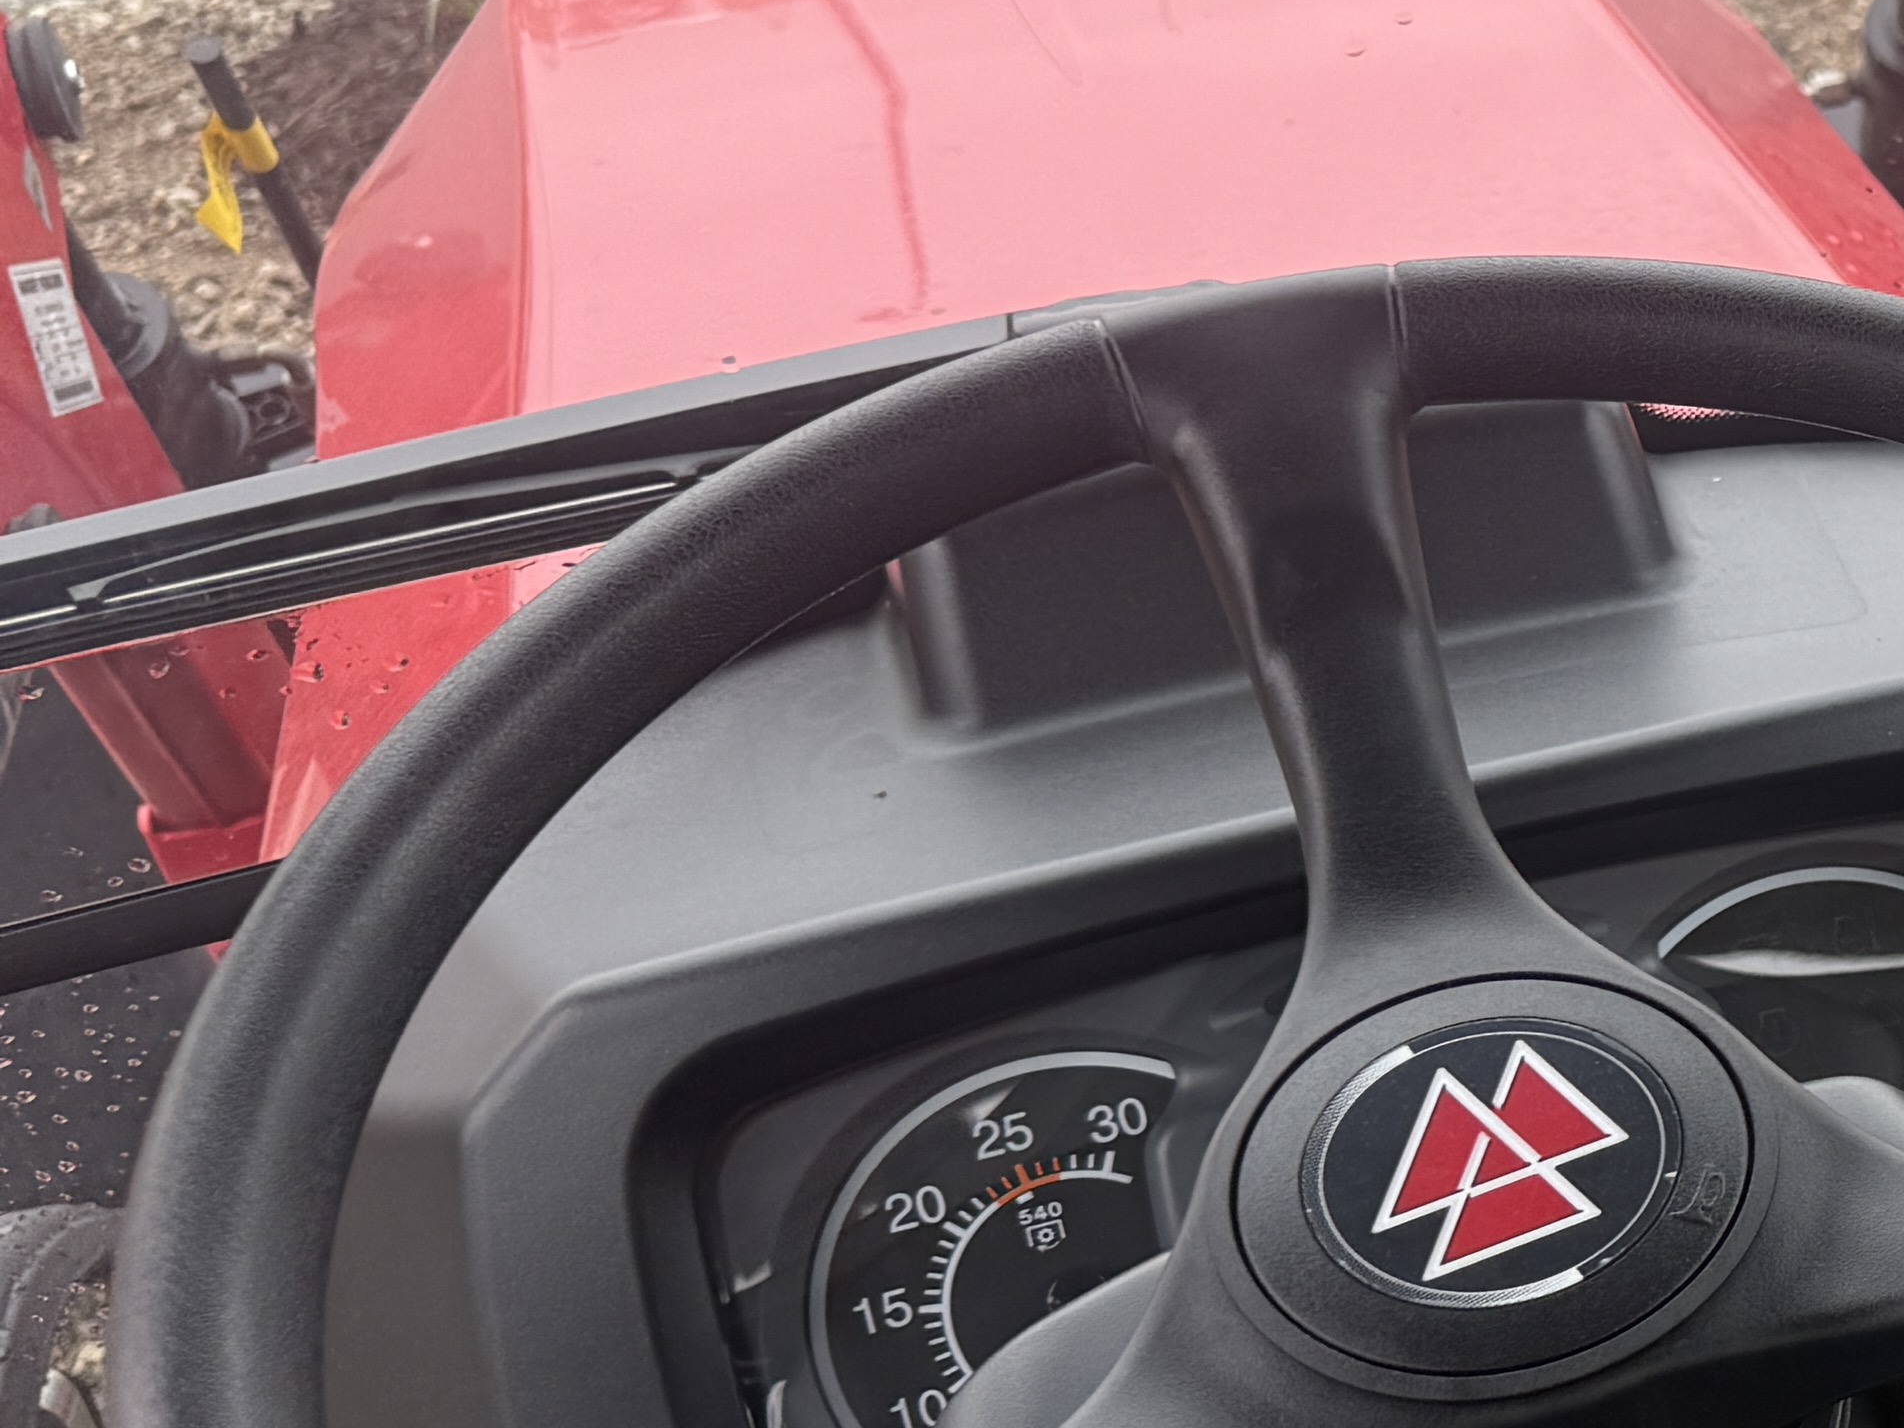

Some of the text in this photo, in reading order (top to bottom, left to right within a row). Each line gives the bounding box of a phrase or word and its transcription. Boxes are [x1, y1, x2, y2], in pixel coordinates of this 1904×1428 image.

[971, 1111, 1034, 1161] 25
[1087, 1097, 1148, 1144] 30
[884, 1185, 947, 1234] 20
[1018, 1201, 1063, 1225] 540
[852, 1287, 913, 1335] 15
